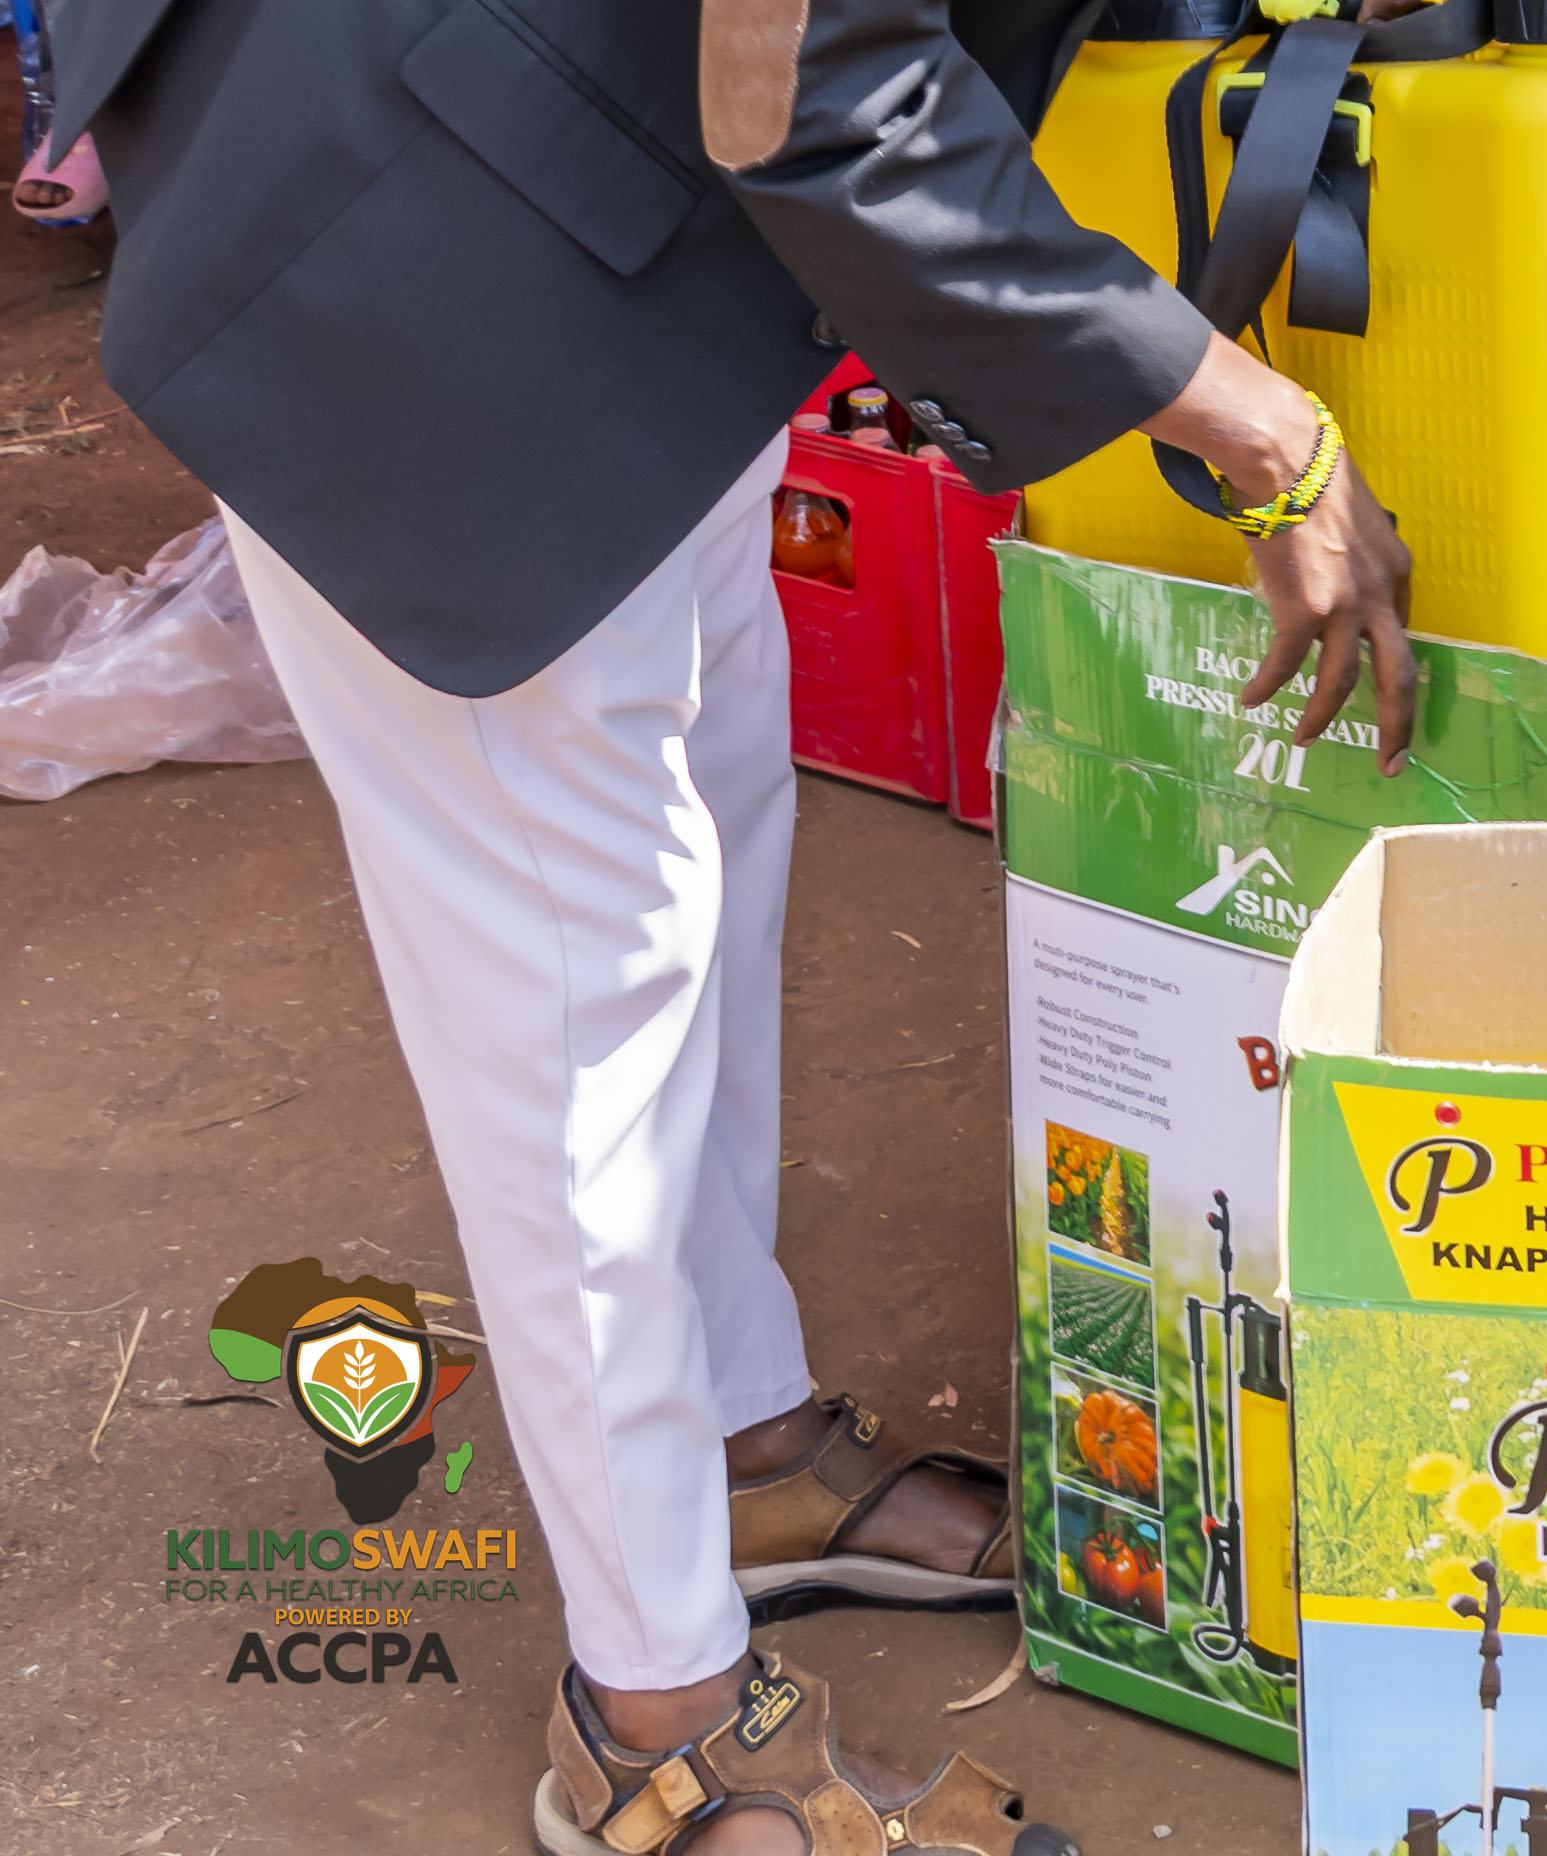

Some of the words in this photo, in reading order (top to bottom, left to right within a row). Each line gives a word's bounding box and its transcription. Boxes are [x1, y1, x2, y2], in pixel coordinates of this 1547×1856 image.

[1233, 732, 1311, 793] 20L
[1234, 889, 1321, 929] SIN
[1033, 958, 1078, 981] designed
[1079, 971, 1093, 987] for
[1095, 981, 1123, 998] every
[1110, 964, 1148, 984] sprayer
[1037, 995, 1073, 1019] Robust
[1073, 1008, 1139, 1040] Construction
[1037, 1015, 1068, 1037] Heavy
[1070, 1025, 1093, 1045] Duty
[1095, 1034, 1131, 1058] Trigger
[1133, 1047, 1173, 1071] Control
[1038, 1034, 1068, 1056] Heavy
[1070, 1045, 1093, 1065] Duty
[1095, 1053, 1118, 1073] Poly
[1119, 1061, 1153, 1083] Piston
[1039, 1053, 1064, 1072] Wide
[1064, 1062, 1097, 1084] Straps
[1098, 1074, 1113, 1088] for
[1114, 1080, 1146, 1099] easier
[1148, 1092, 1168, 1107] and
[1039, 1073, 1065, 1091] more
[1065, 1083, 1127, 1113] comfortable
[1127, 1104, 1172, 1131] carrying
